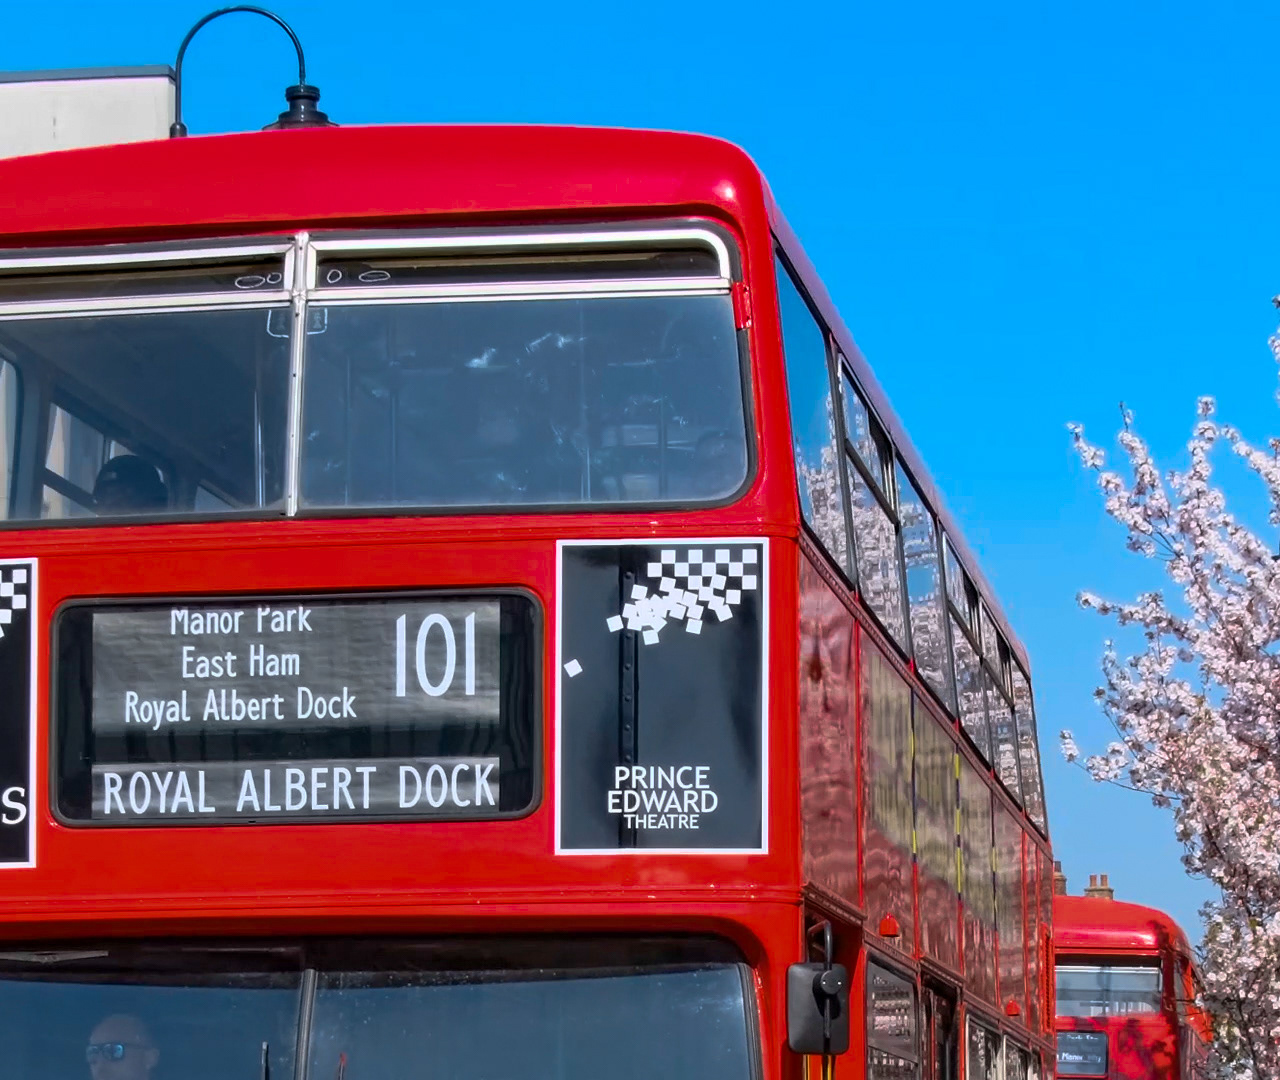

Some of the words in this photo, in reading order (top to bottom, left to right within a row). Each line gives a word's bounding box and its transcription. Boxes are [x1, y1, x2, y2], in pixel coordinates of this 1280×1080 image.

[171, 609, 244, 636] Manor
[182, 646, 237, 679] East
[250, 644, 300, 677] Ham
[396, 612, 476, 698] 101
[125, 690, 191, 731] Royal
[203, 688, 285, 722] Albert
[297, 686, 357, 720] Dock
[103, 770, 217, 815] ROYAL
[236, 766, 377, 812] ALBERT
[398, 762, 496, 809] DOCK
[615, 765, 711, 790] PRINCE
[607, 789, 719, 814] EDWARD
[623, 813, 700, 829] THEATRE
